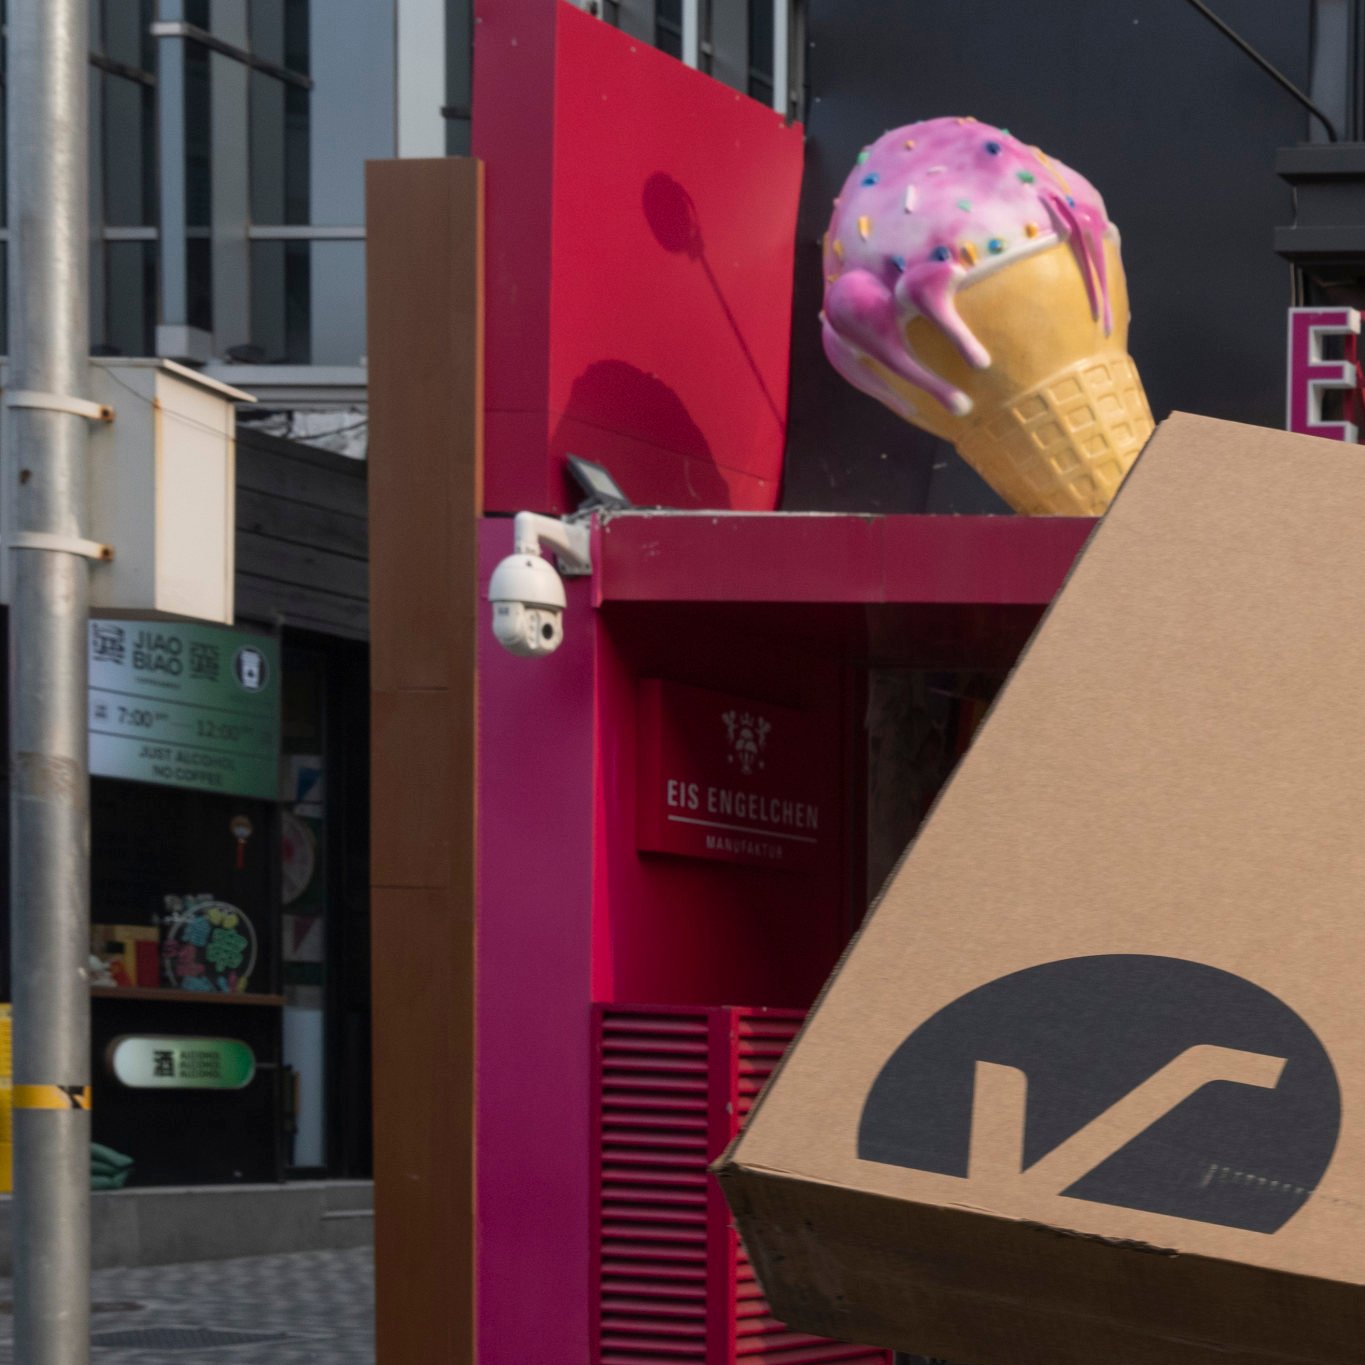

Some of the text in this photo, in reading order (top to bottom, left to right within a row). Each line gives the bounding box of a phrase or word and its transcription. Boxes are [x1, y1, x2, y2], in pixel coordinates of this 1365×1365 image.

[133, 631, 183, 656] JIAO
[132, 651, 184, 677] BIAO
[667, 779, 819, 830] EIS ENGELCHEN
[706, 834, 784, 860] MANUFAKTUR
